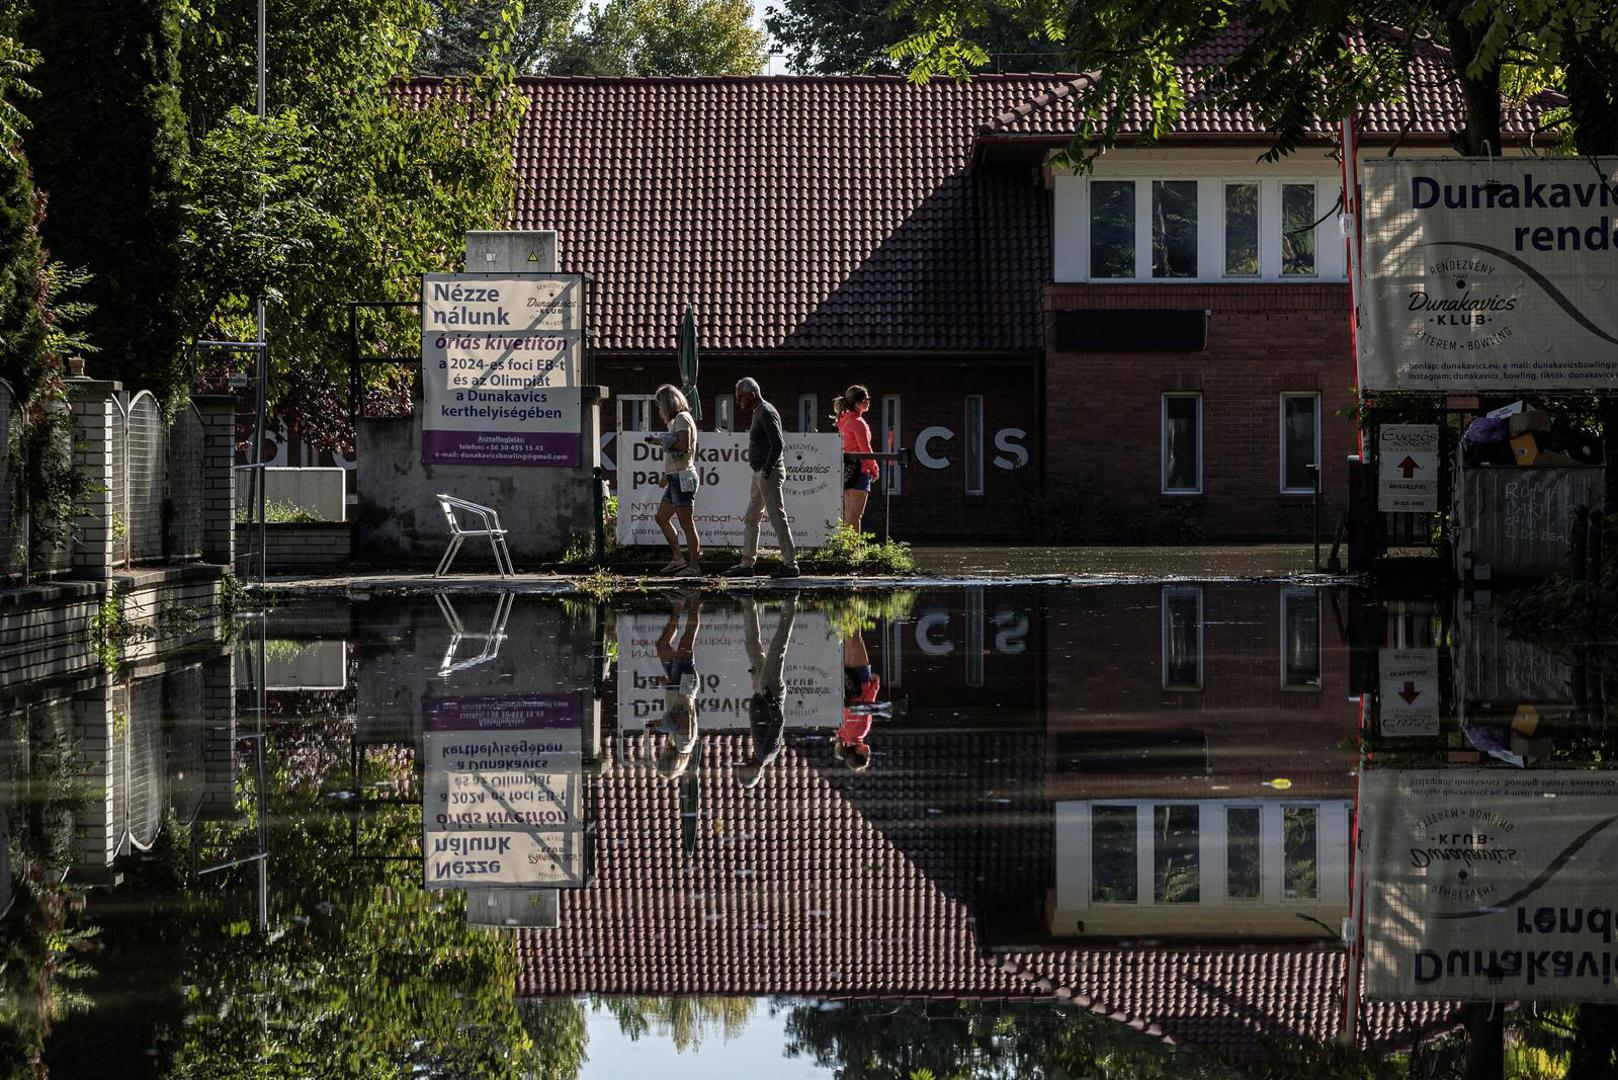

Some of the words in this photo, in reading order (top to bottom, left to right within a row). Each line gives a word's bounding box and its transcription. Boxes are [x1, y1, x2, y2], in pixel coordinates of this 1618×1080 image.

[1430, 260, 1496, 275] RENDEZVÉNY
[434, 283, 500, 303] Nézze
[1408, 291, 1517, 311] Dunakavics
[434, 307, 510, 326] nálunk
[1438, 315, 1486, 326] KLUB
[435, 332, 481, 350] óriás
[485, 332, 568, 351] kivetítőn
[1468, 326, 1513, 351] BOWLING
[439, 361, 447, 370] a
[450, 358, 504, 371] 2024-es
[508, 358, 533, 371] foci
[537, 359, 565, 371] EB-t
[454, 374, 468, 386] és
[472, 378, 487, 386] az
[490, 374, 551, 389] Olimpiát
[456, 392, 465, 401] a
[468, 390, 547, 403] Dunakavics
[442, 405, 563, 422] kerthelyiségében
